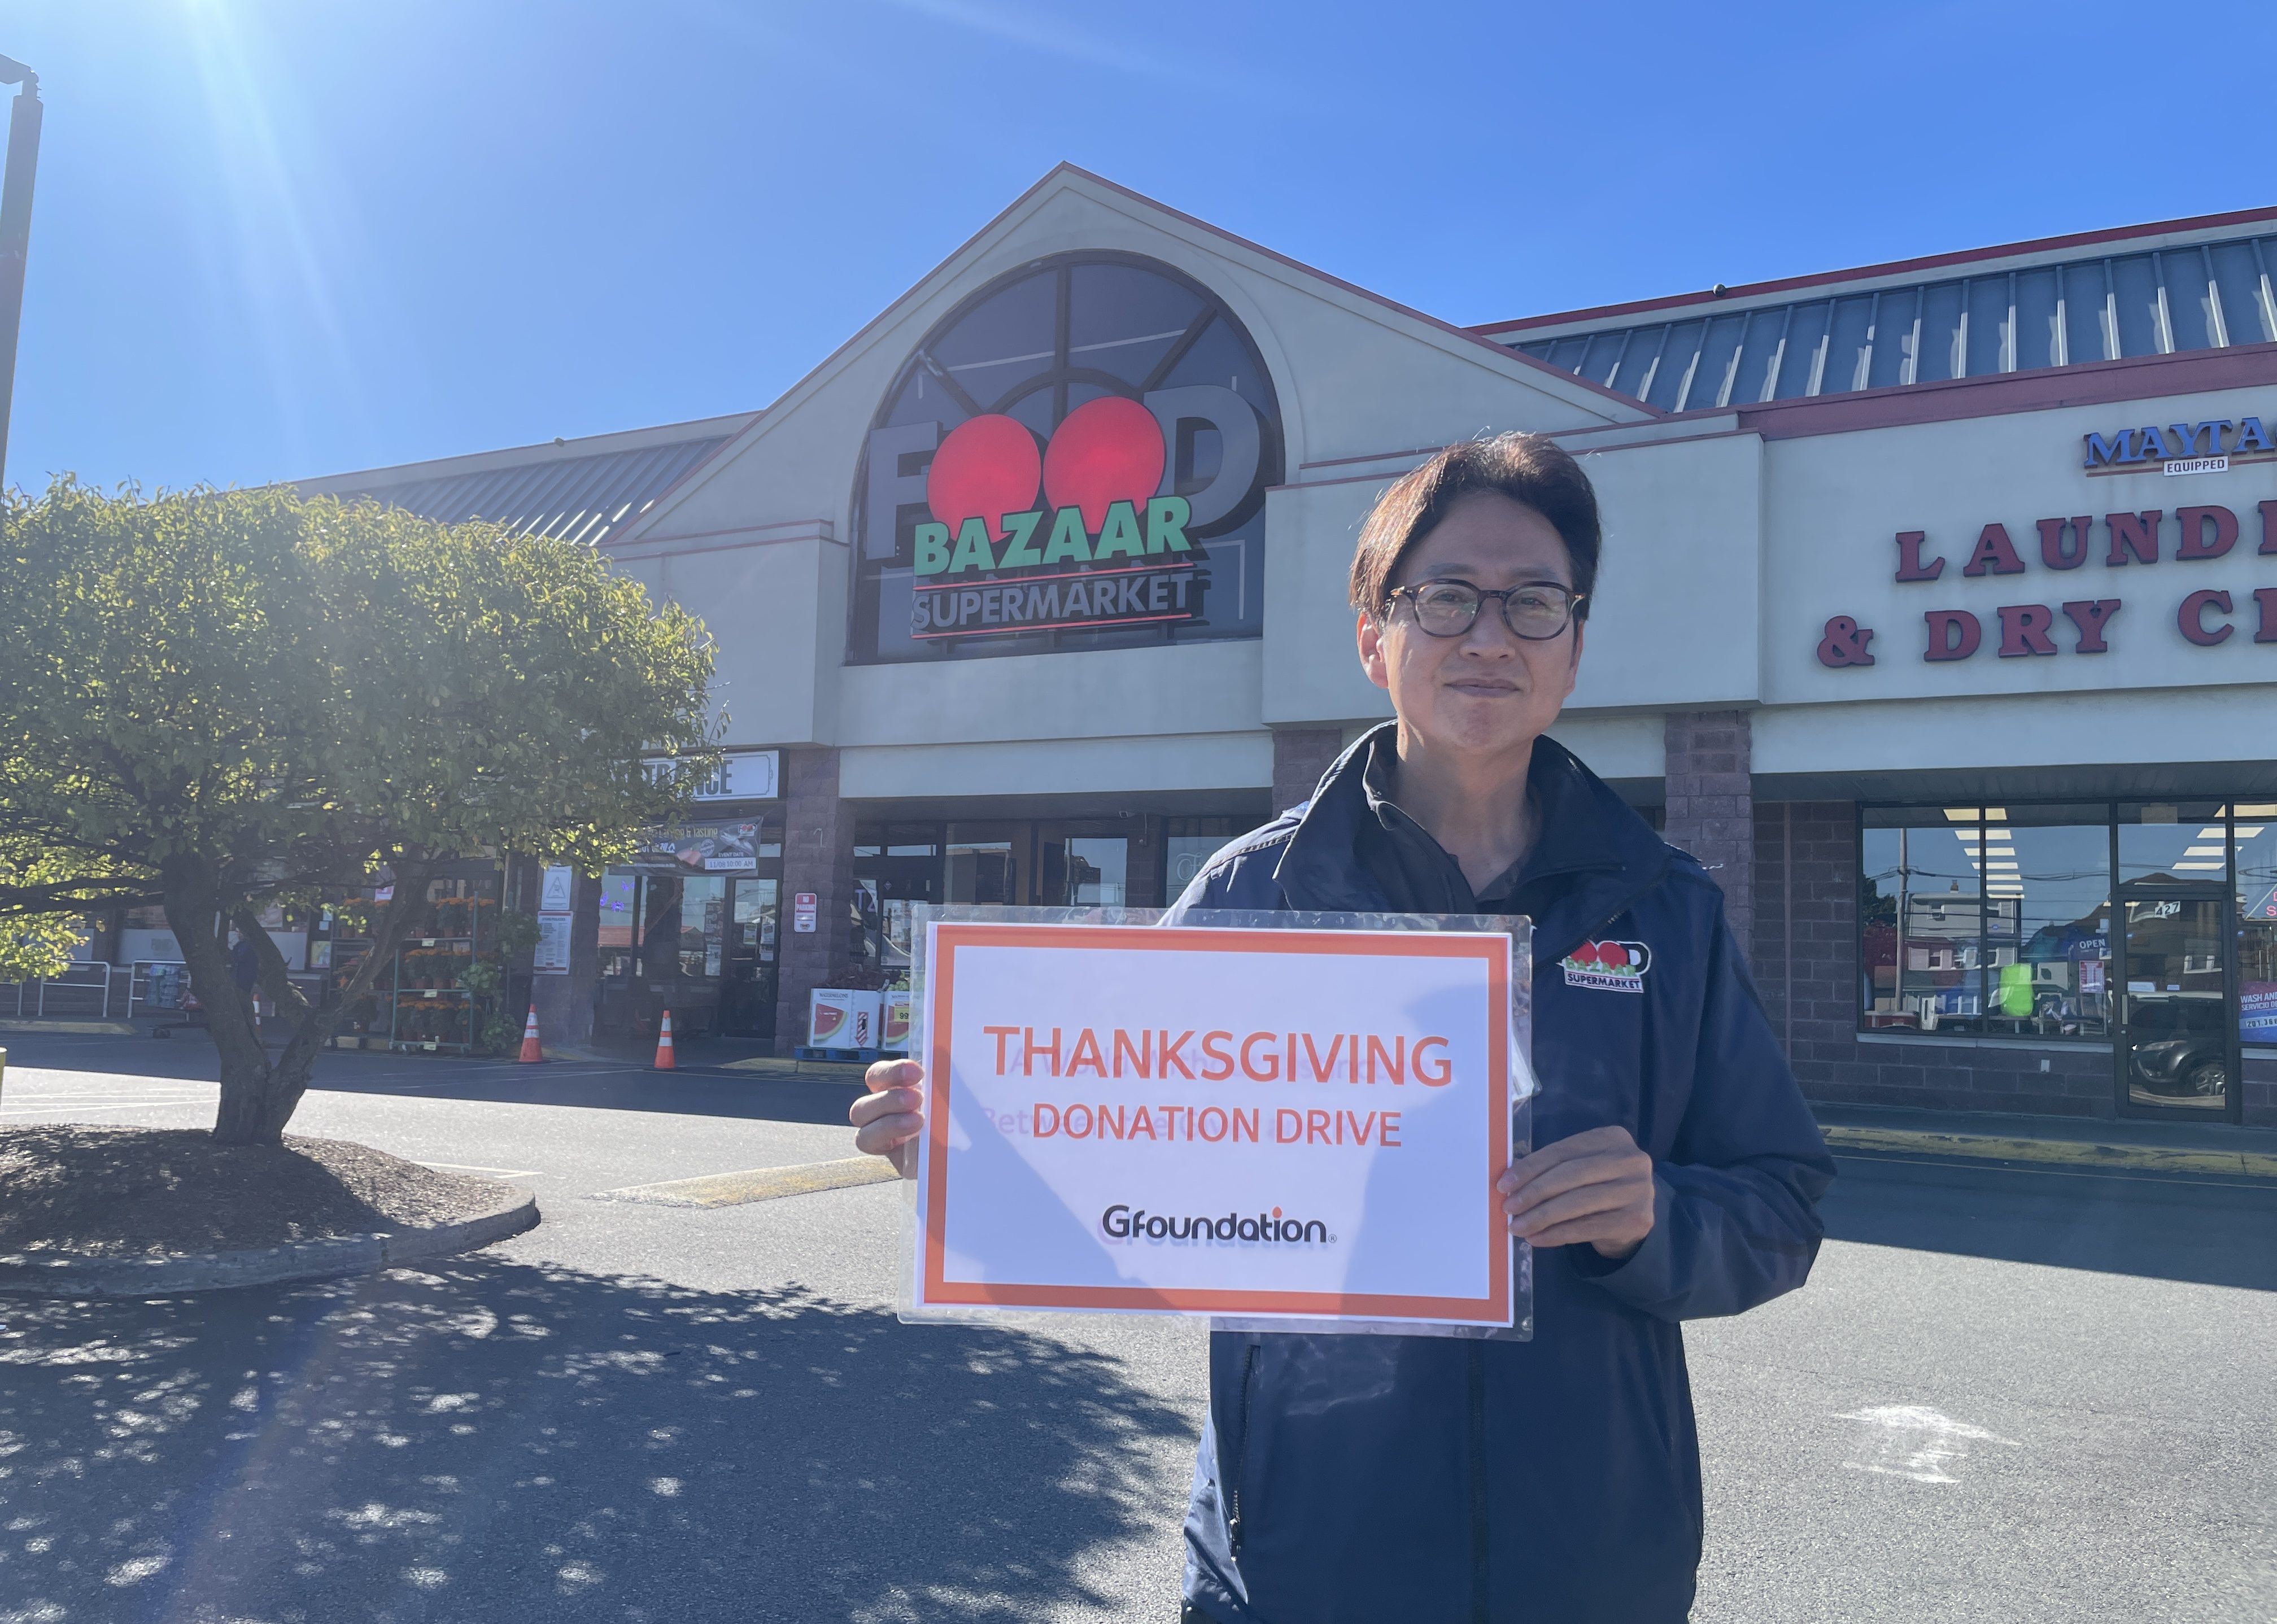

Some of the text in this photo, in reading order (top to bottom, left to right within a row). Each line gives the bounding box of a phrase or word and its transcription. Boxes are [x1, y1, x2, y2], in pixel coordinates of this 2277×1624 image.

[2084, 417, 2277, 468] MAYTA
[2167, 459, 2225, 473] EQUIPPED
[914, 496, 1192, 577] BAZAAR
[912, 572, 1194, 630] SUPERMARKET
[1817, 615, 1875, 668] &
[1923, 598, 2122, 663] DRY
[2156, 903, 2179, 916] 427
[2079, 938, 2105, 949] OPEN
[1565, 958, 1637, 977] BAZAAR
[1568, 973, 1639, 989] SUPERMARKET
[2240, 993, 2262, 1003] WASH
[2241, 1002, 2269, 1011] SERVICIO
[983, 1026, 1452, 1088] THANKSGIVING
[1033, 1103, 1259, 1144] DONATION
[1276, 1108, 1402, 1147] DRIVE
